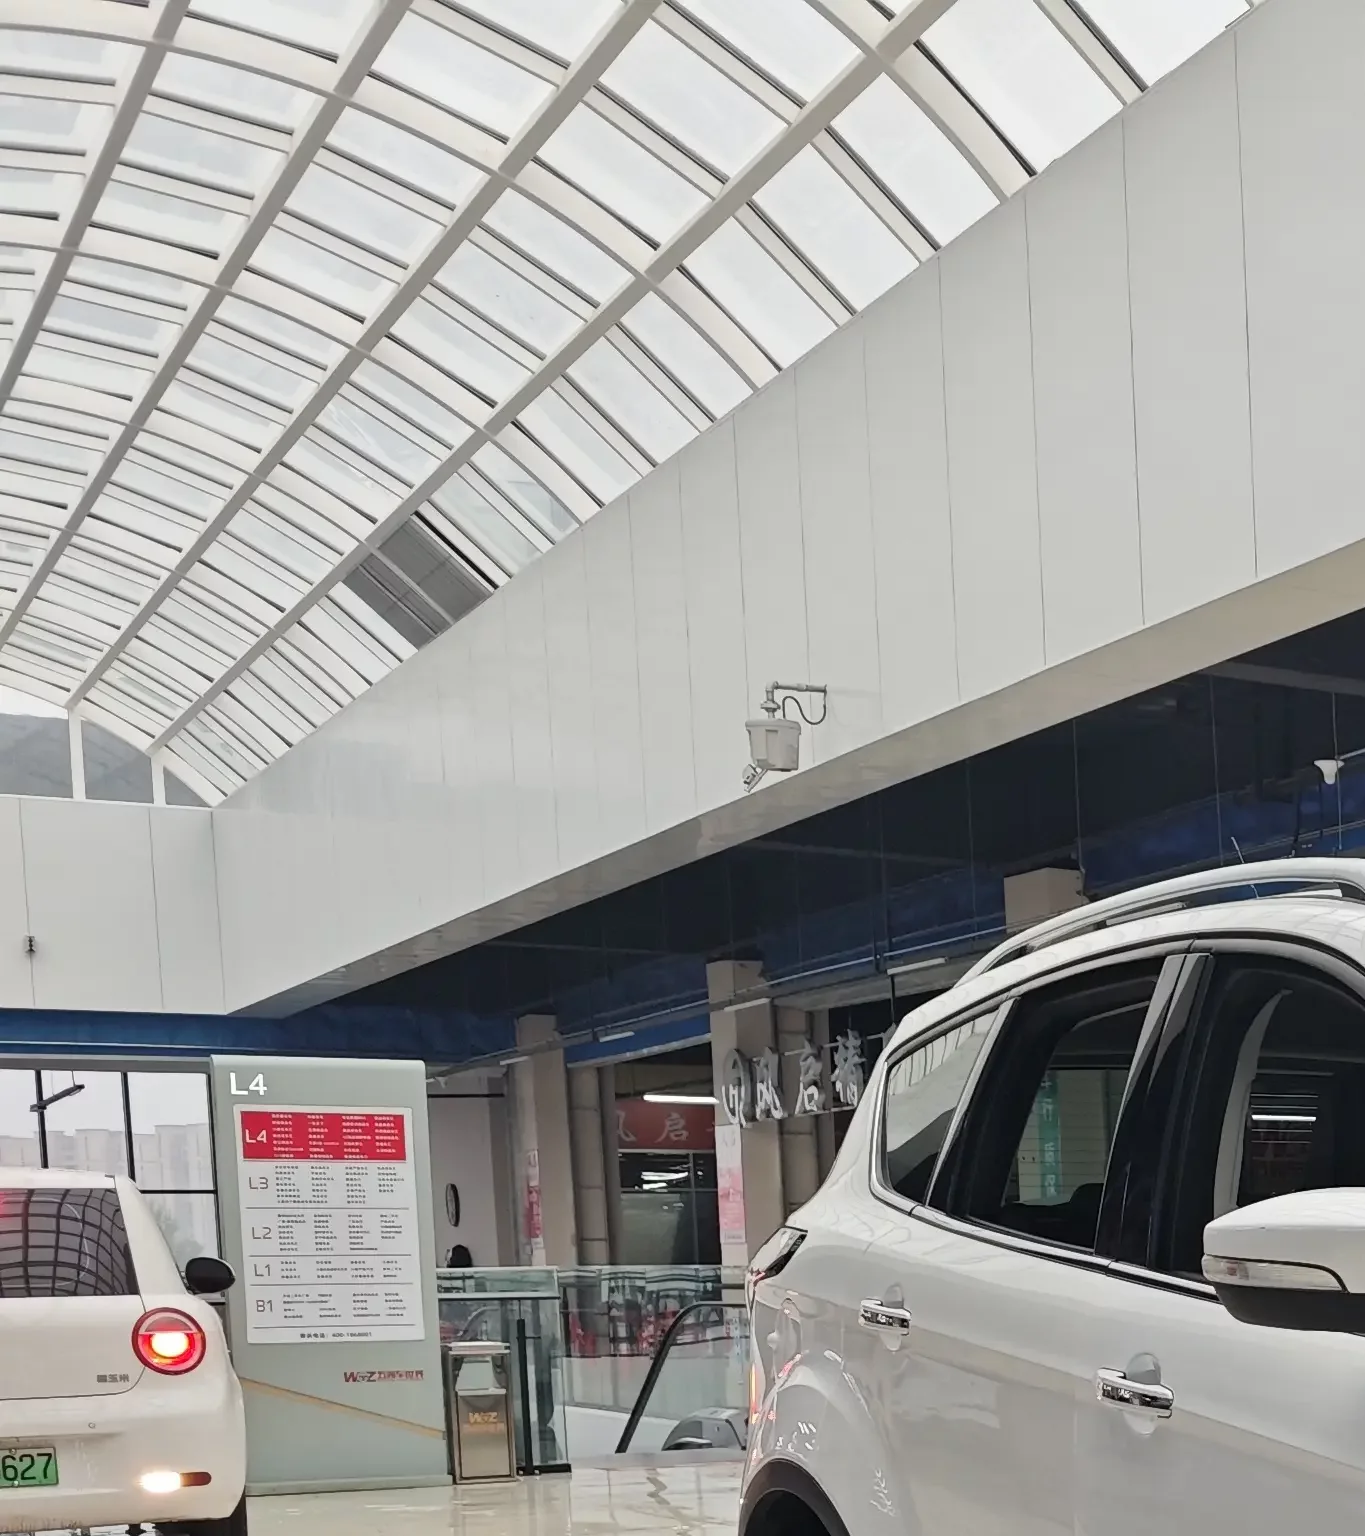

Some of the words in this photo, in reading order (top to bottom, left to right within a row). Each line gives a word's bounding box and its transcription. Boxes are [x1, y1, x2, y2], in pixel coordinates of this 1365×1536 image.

[229, 1072, 268, 1096] L4
[244, 1129, 268, 1144] L4
[248, 1176, 269, 1190] L3
[251, 1226, 273, 1240] L2
[253, 1263, 272, 1278] L1
[255, 1299, 274, 1313] B1
[1, 1453, 53, 1482] 627
